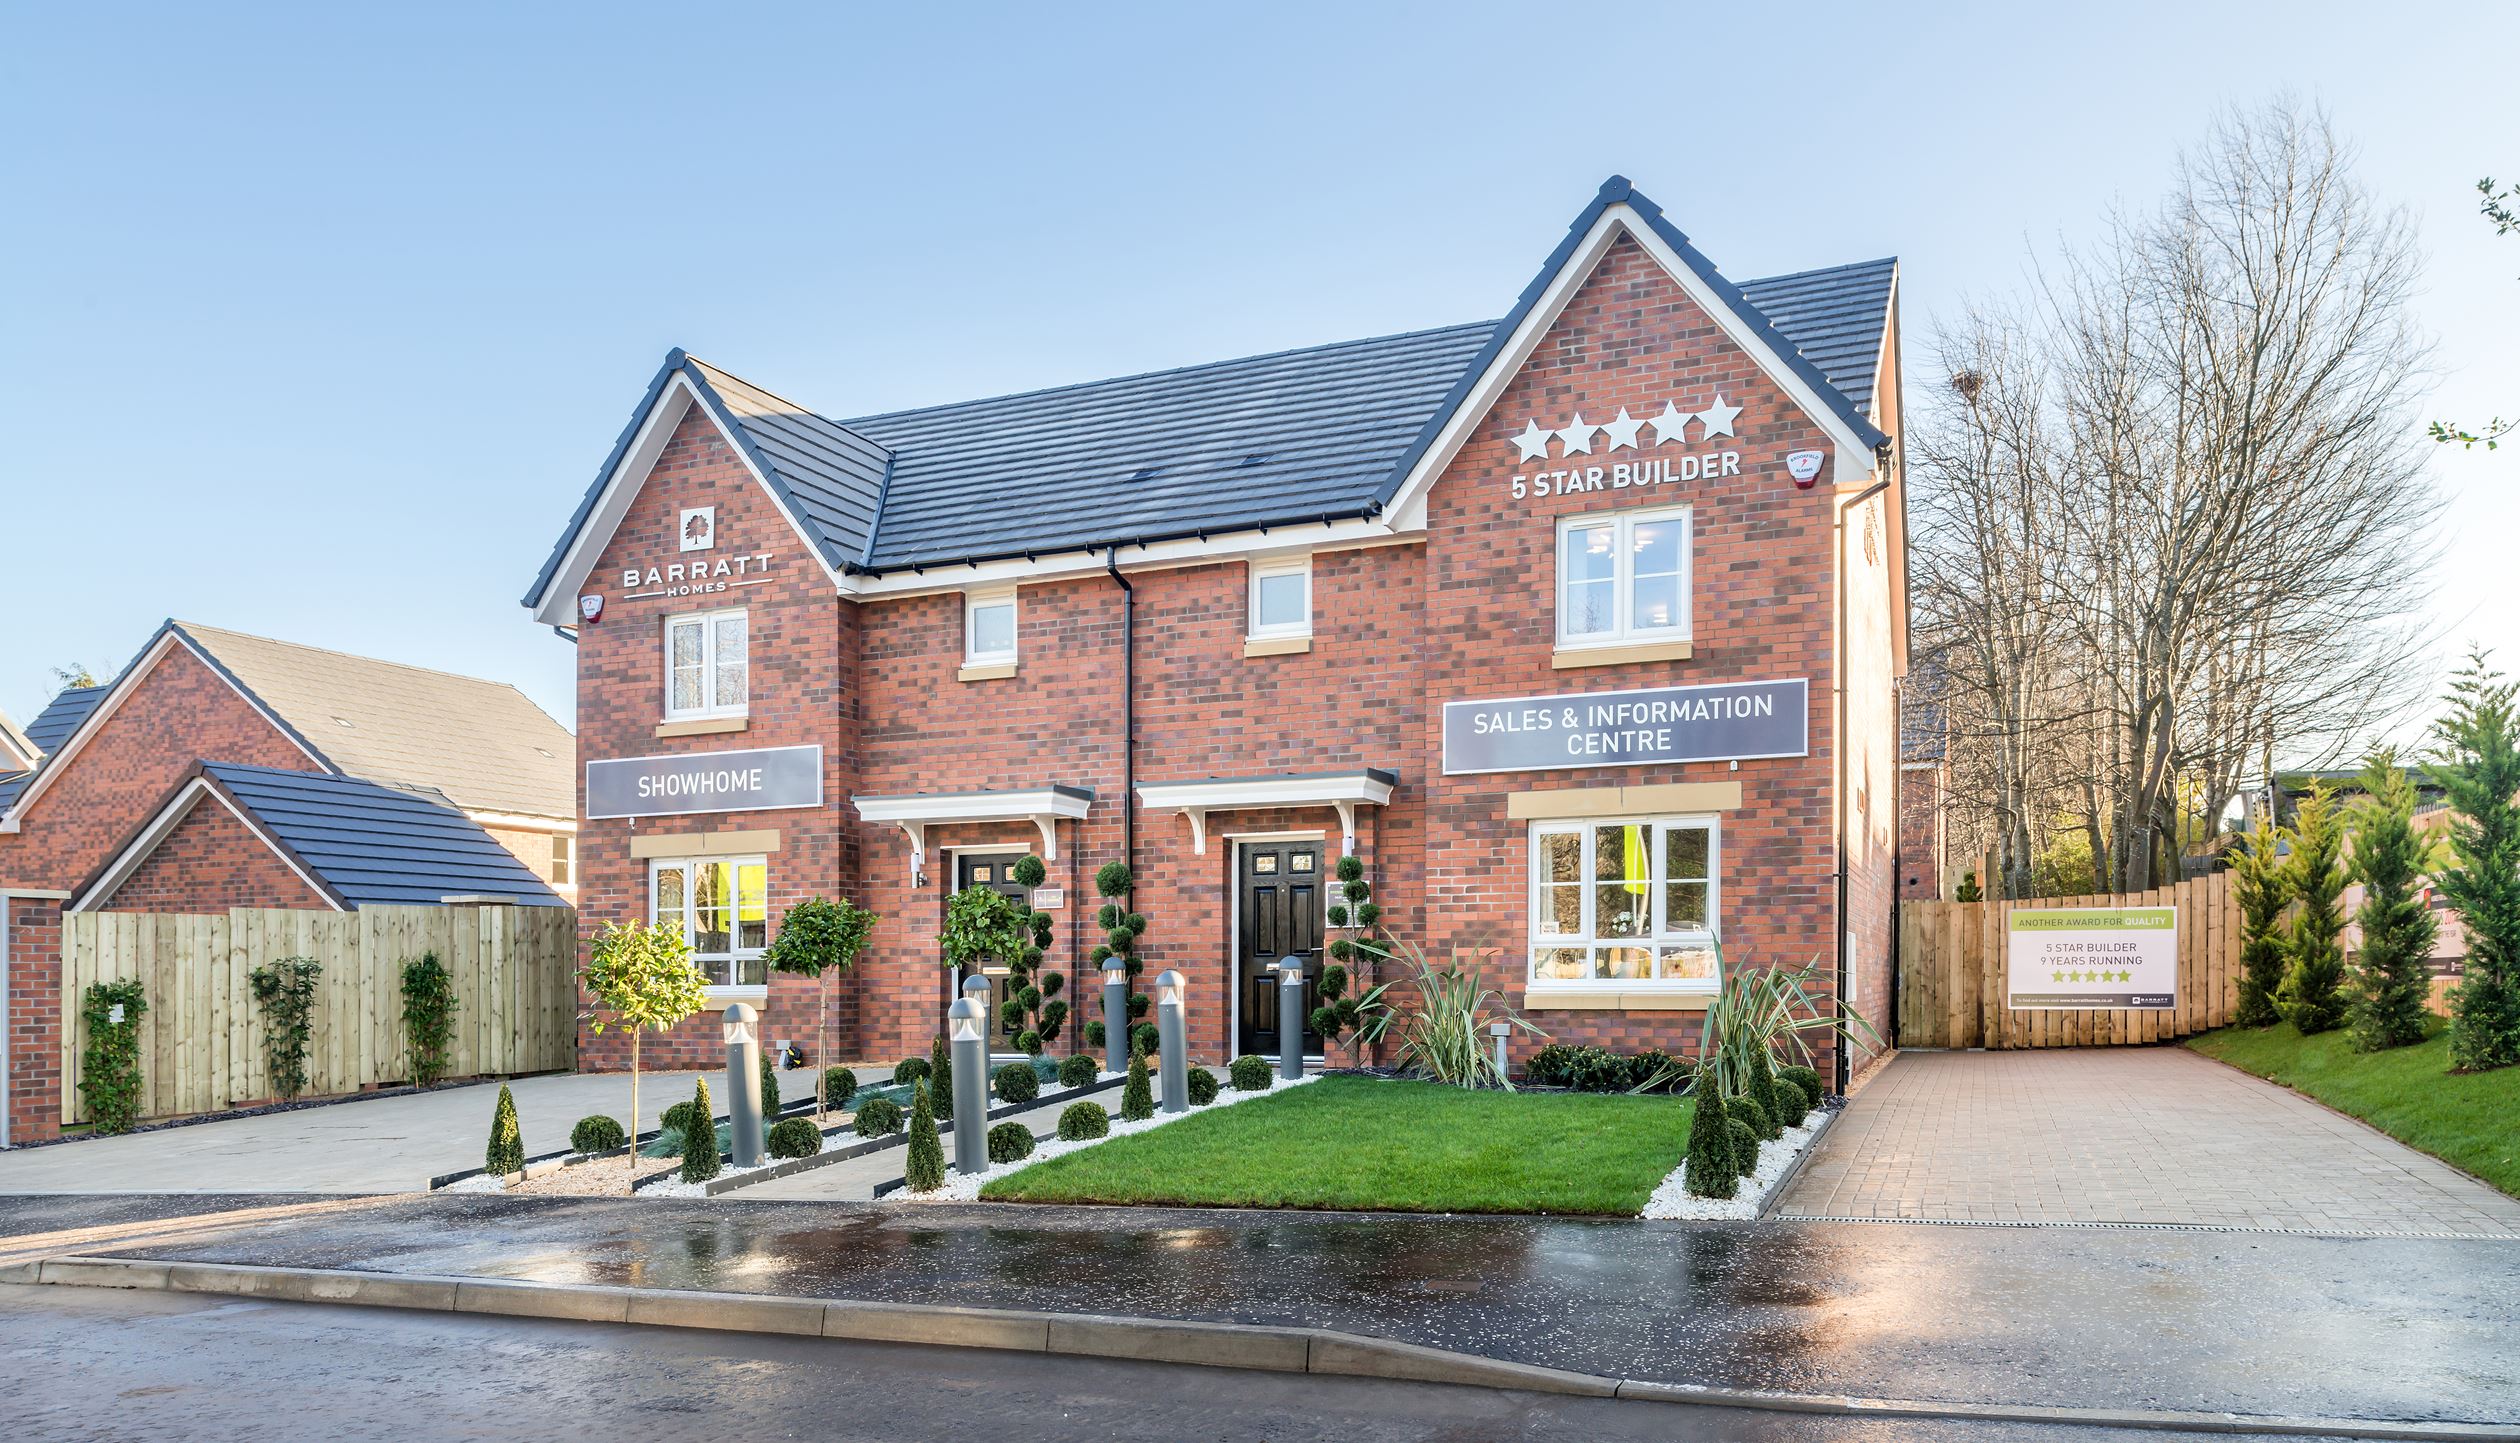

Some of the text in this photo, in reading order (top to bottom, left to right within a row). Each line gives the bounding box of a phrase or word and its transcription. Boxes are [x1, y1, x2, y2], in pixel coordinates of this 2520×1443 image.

[1511, 451, 1741, 500] 5 STAR BUILDER
[623, 553, 774, 588] BARRATT
[667, 581, 727, 598] HOMES
[1473, 694, 1774, 735] SALES & INFORMATION
[1567, 728, 1672, 756] CENTRE
[638, 768, 763, 798] SHOWHOME
[2018, 916, 2166, 927] ANOTHER AWARD FOR QUALITY
[2040, 955, 2143, 966] 9 YEARS RUNNING
[2046, 942, 2137, 953] 5 STAR BUILDER
